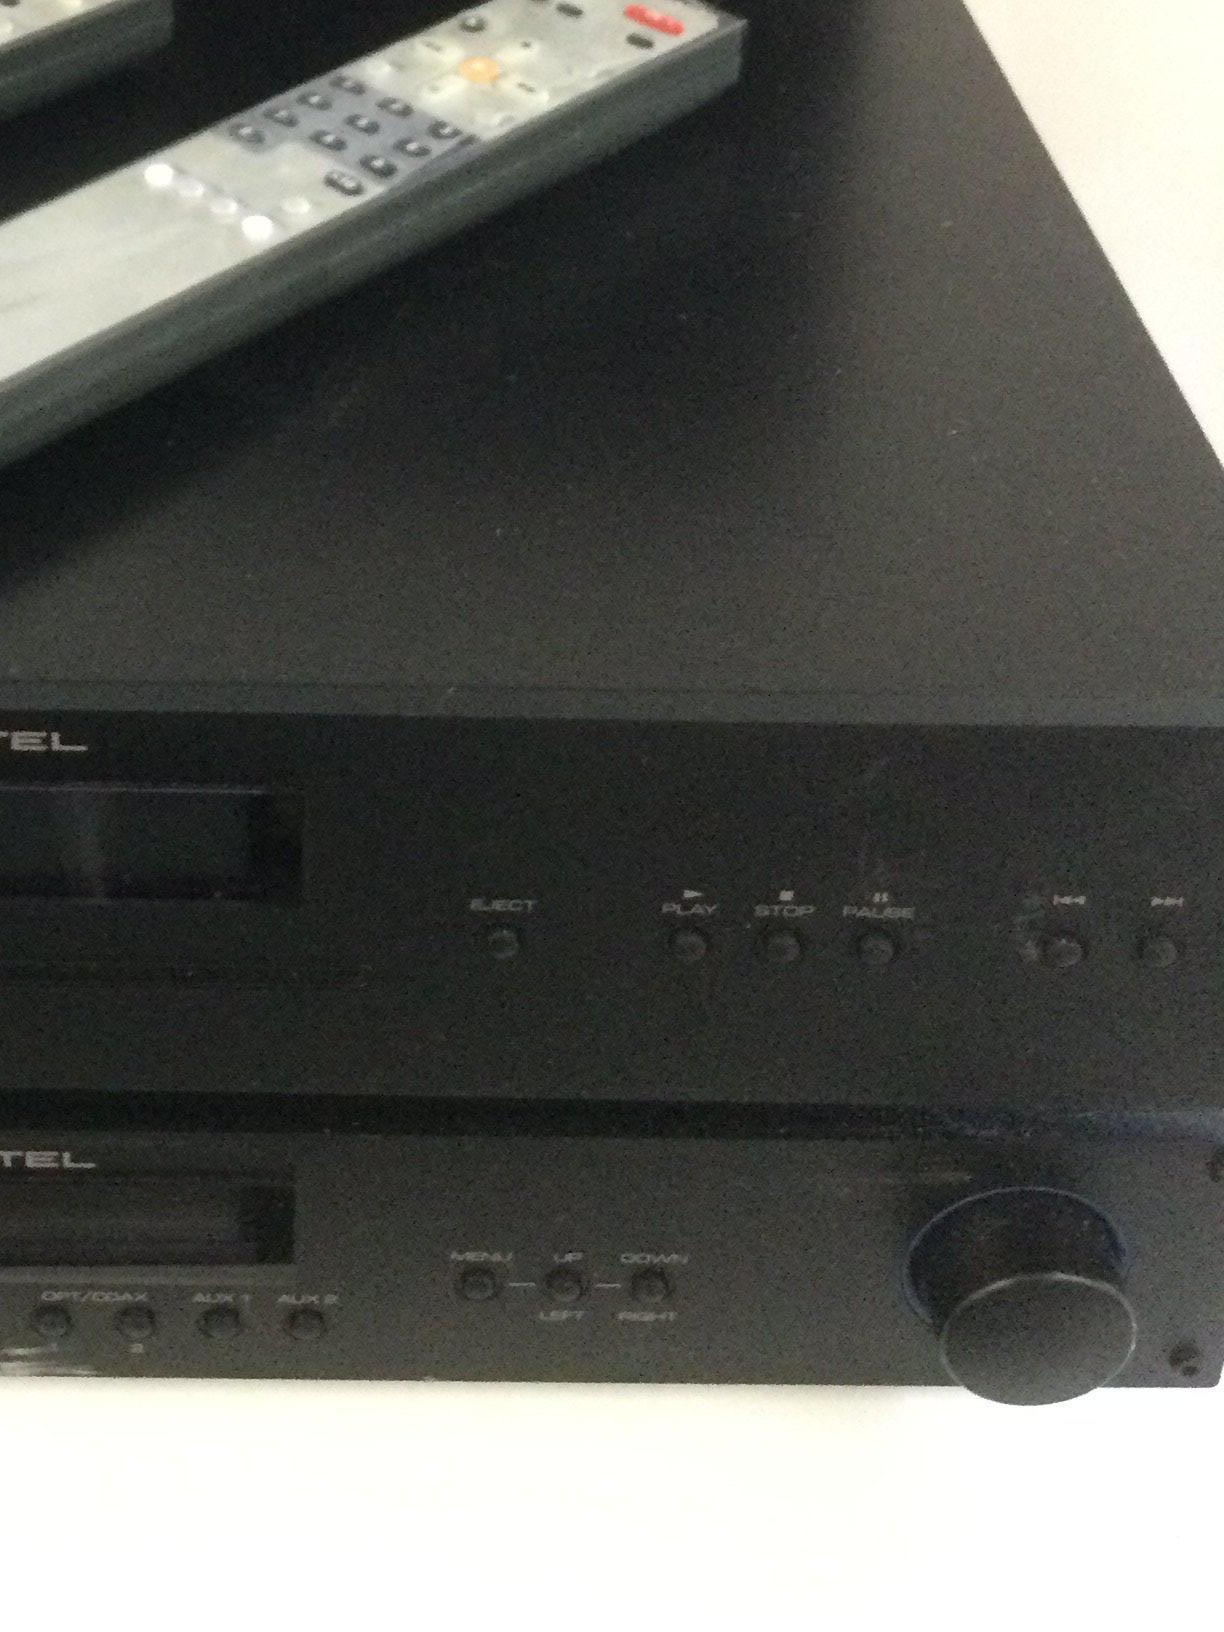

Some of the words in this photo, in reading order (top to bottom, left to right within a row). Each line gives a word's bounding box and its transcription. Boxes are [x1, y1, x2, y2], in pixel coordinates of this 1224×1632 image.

[469, 898, 538, 913] EJECT
[660, 901, 720, 916] PLAY
[753, 903, 816, 918] STOP
[841, 904, 916, 920] PAUSE
[552, 1251, 584, 1264] UP
[619, 1252, 689, 1265] DOWN
[192, 1291, 234, 1304] AUX
[276, 1293, 321, 1305] AUX
[538, 1309, 586, 1322] LEFT
